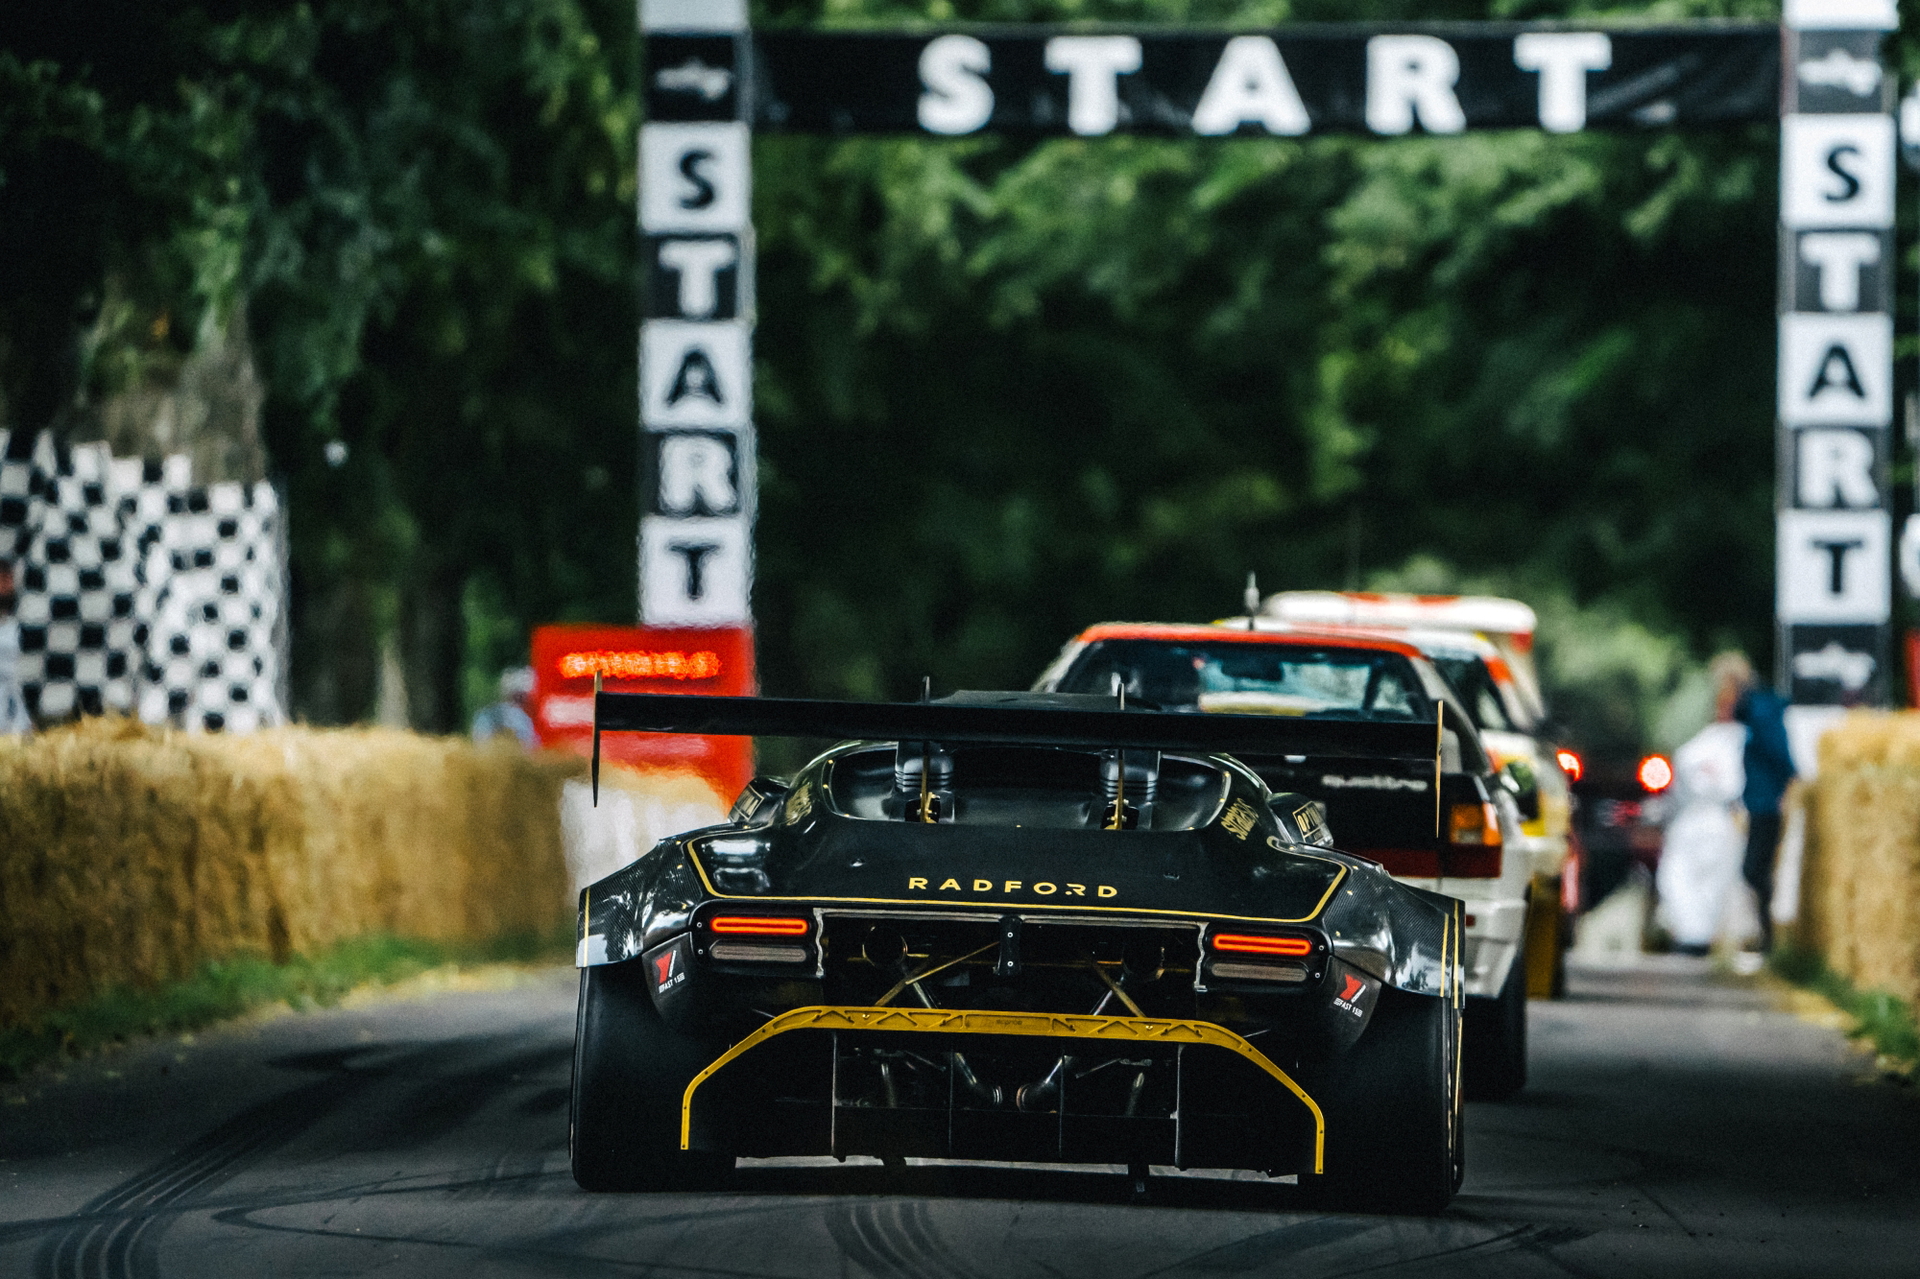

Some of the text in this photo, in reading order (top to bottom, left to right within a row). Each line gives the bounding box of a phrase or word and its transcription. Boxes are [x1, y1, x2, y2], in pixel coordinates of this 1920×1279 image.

[916, 31, 1613, 137] START
[657, 149, 738, 600] START
[1796, 144, 1881, 595] START
[908, 877, 1118, 898] RADFORD
